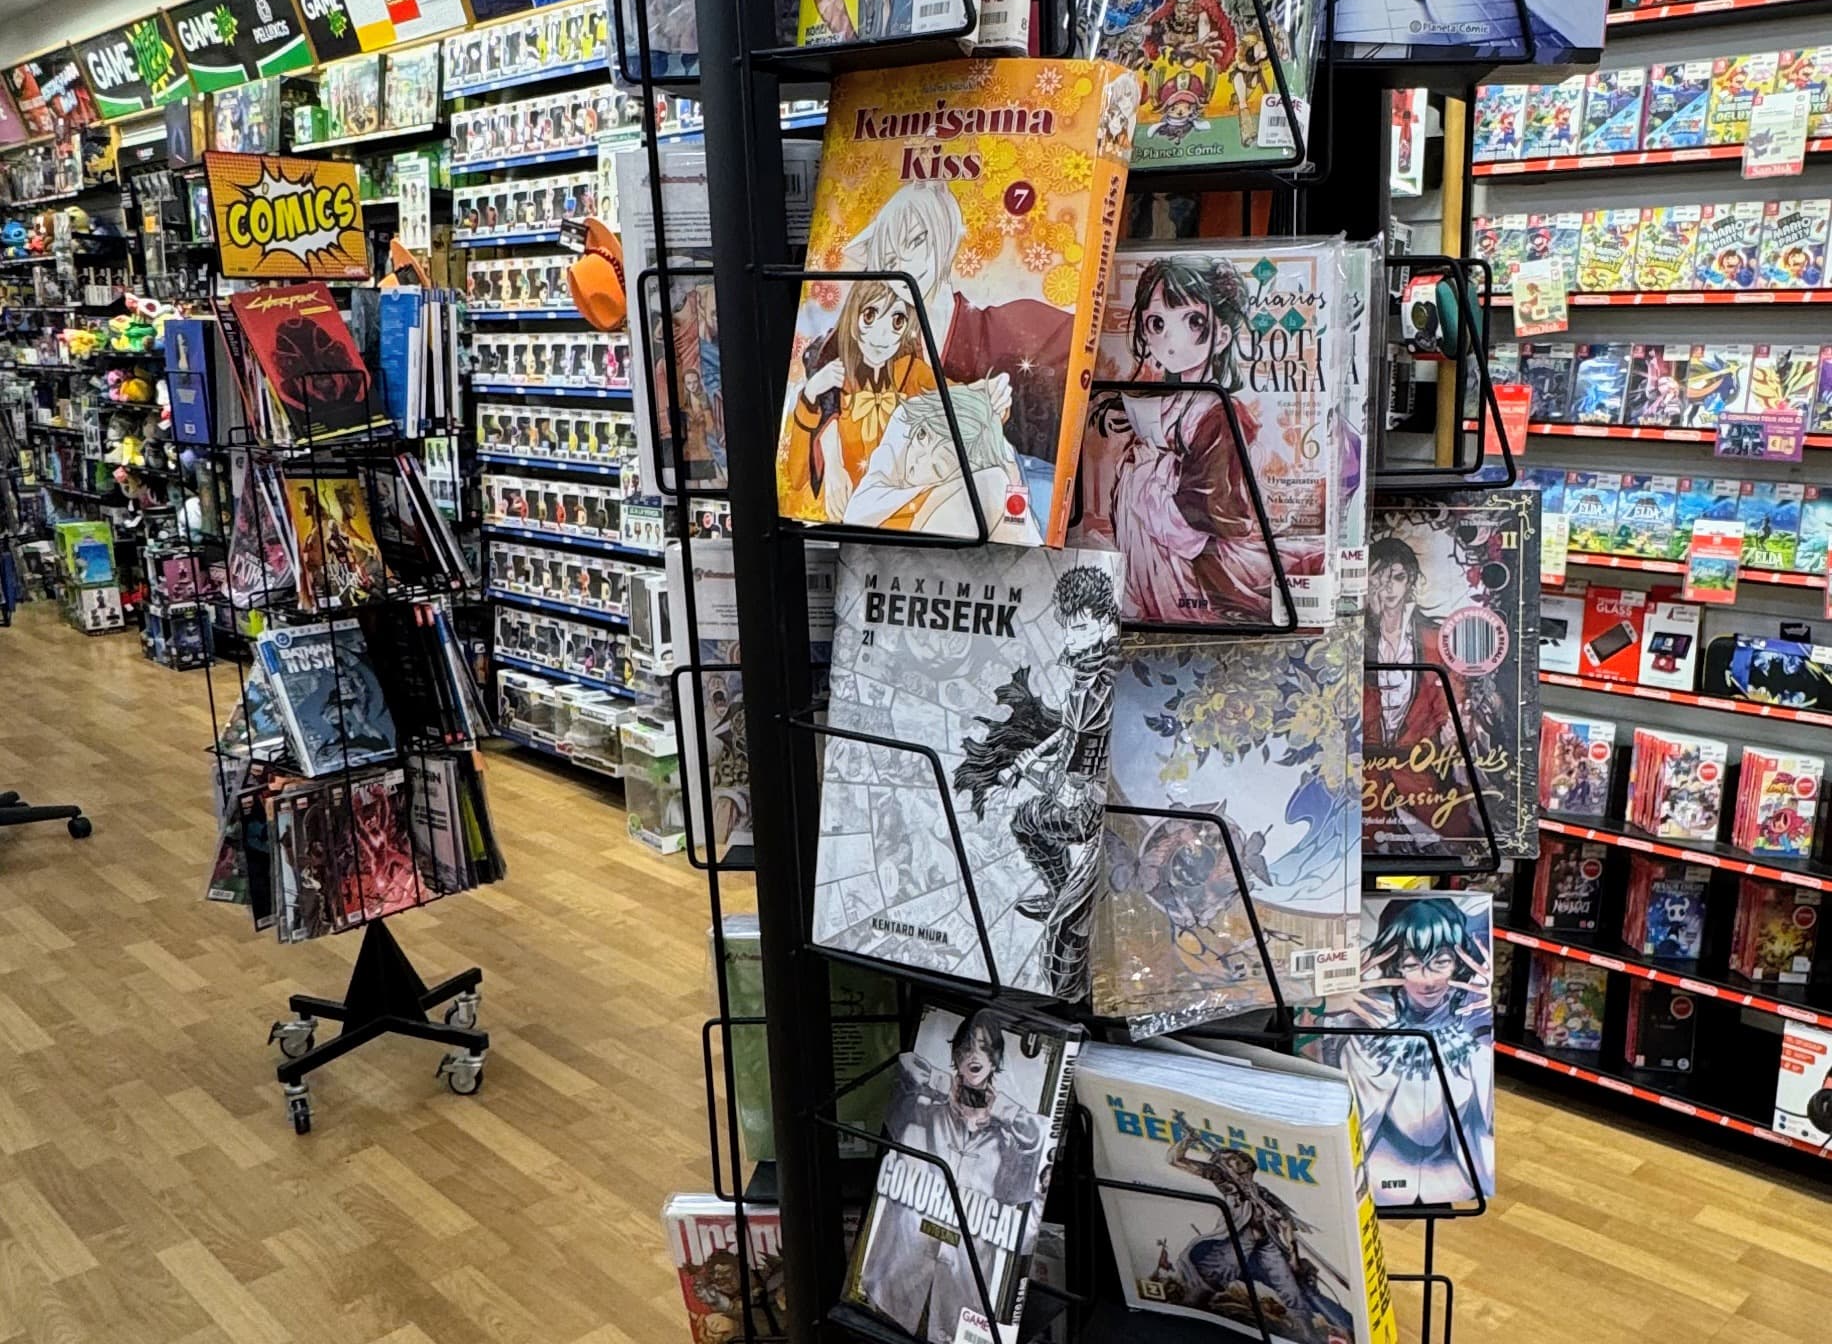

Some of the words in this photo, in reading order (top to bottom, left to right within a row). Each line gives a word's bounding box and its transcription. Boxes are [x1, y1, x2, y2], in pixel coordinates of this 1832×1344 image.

[177, 12, 223, 53] GAME
[87, 42, 140, 90] GAME
[854, 99, 1054, 141] Kamisama
[901, 142, 981, 182] Kiss
[1752, 164, 1794, 176] SanDisk
[1012, 189, 1028, 208] 7
[228, 182, 356, 247] COMICS
[1707, 219, 1745, 243] MARIO
[1713, 231, 1745, 250] PARTY
[1772, 217, 1812, 242] MARIO
[1778, 229, 1812, 249] PARTY
[1249, 282, 1326, 310] diarios
[1301, 422, 1321, 460] 6
[1566, 502, 1602, 518] ZELDA
[1622, 503, 1661, 521] ZELDA
[1501, 531, 1518, 550] II
[1340, 551, 1365, 562] AME
[1743, 548, 1784, 569] ZELDA
[865, 573, 1023, 604] MAXIMUM
[865, 592, 1019, 639] BERSERK
[1596, 602, 1634, 618] GLASS
[861, 629, 875, 647] 21
[1361, 777, 1504, 829] Blessing
[872, 917, 915, 940] KENTARO
[917, 925, 949, 946] MIURA
[1317, 950, 1348, 963] GAME
[1381, 1179, 1408, 1191] DEVIR
[962, 1309, 990, 1332] GAME
